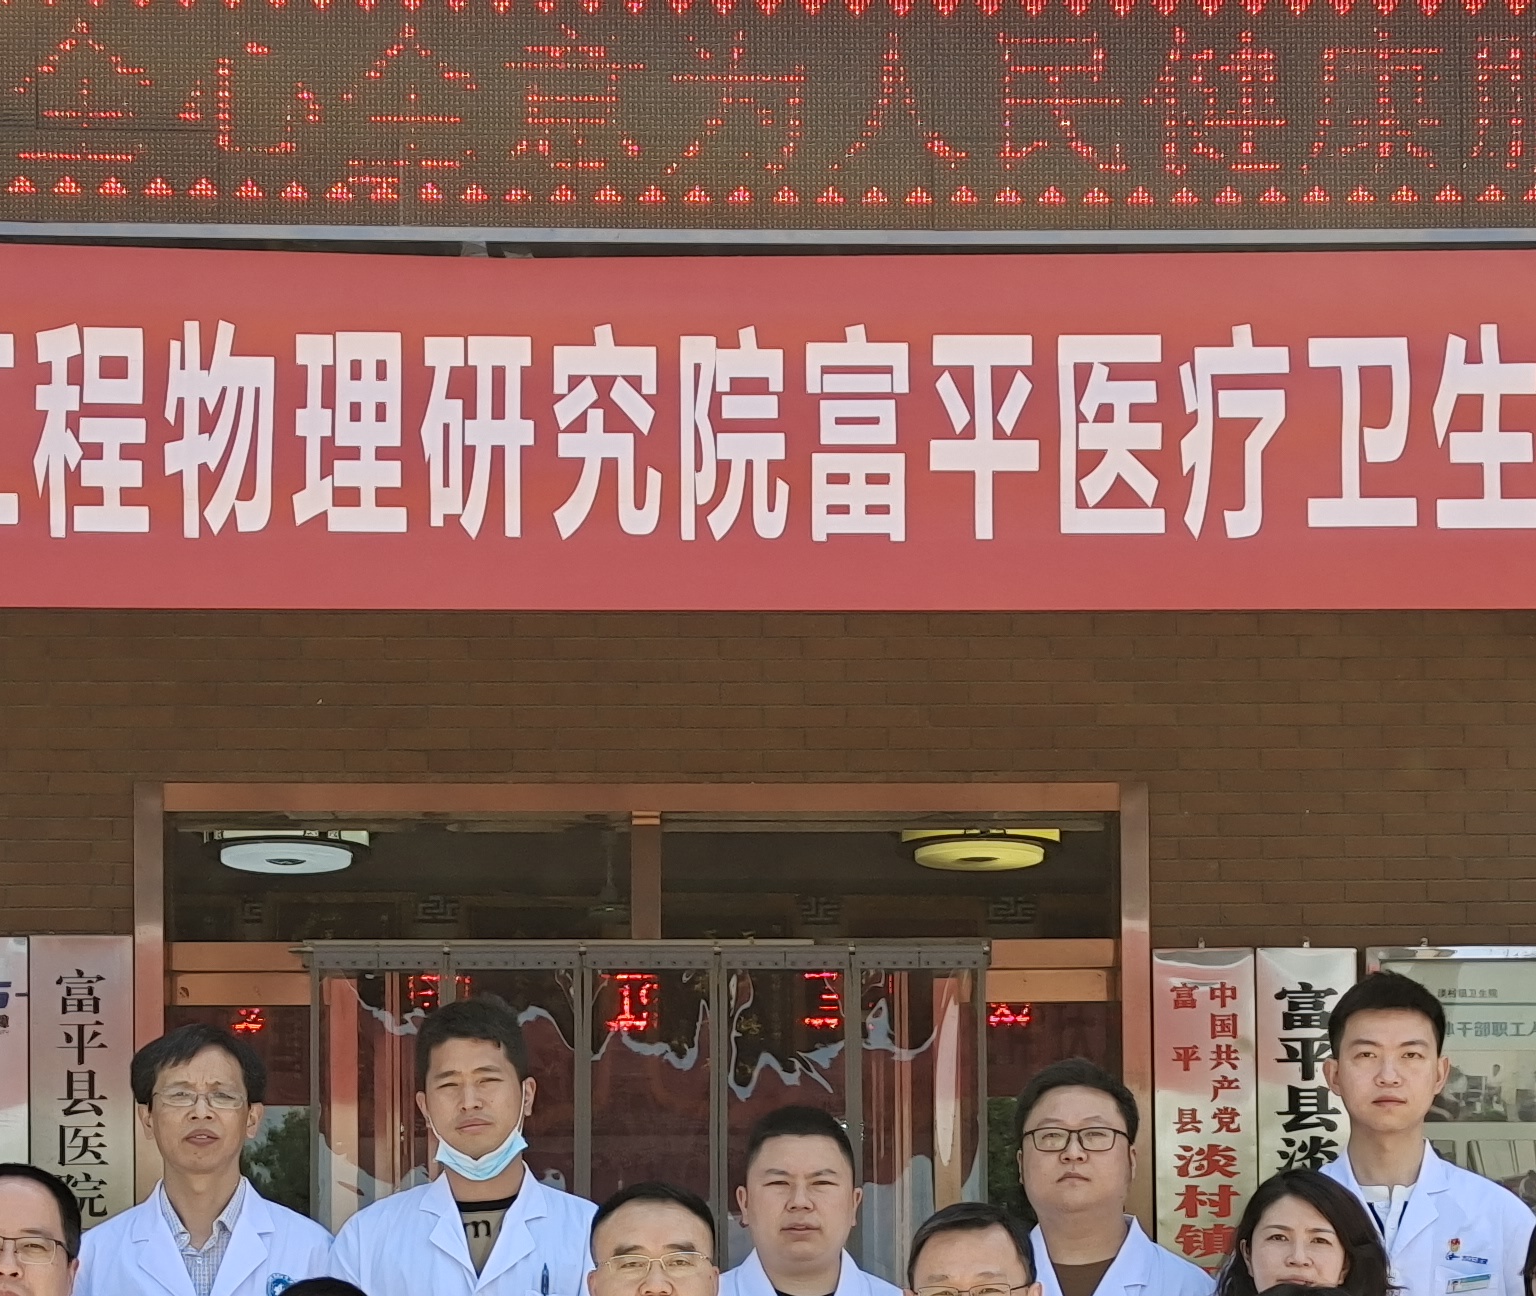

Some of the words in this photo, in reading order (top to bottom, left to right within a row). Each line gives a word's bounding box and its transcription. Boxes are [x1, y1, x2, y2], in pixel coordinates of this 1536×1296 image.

[55, 968, 109, 1218] 富平县医院
[1169, 982, 1204, 1135] 富平县
[1208, 981, 1242, 1135] 中国共产党
[1173, 1142, 1242, 1268] 淡村镇
